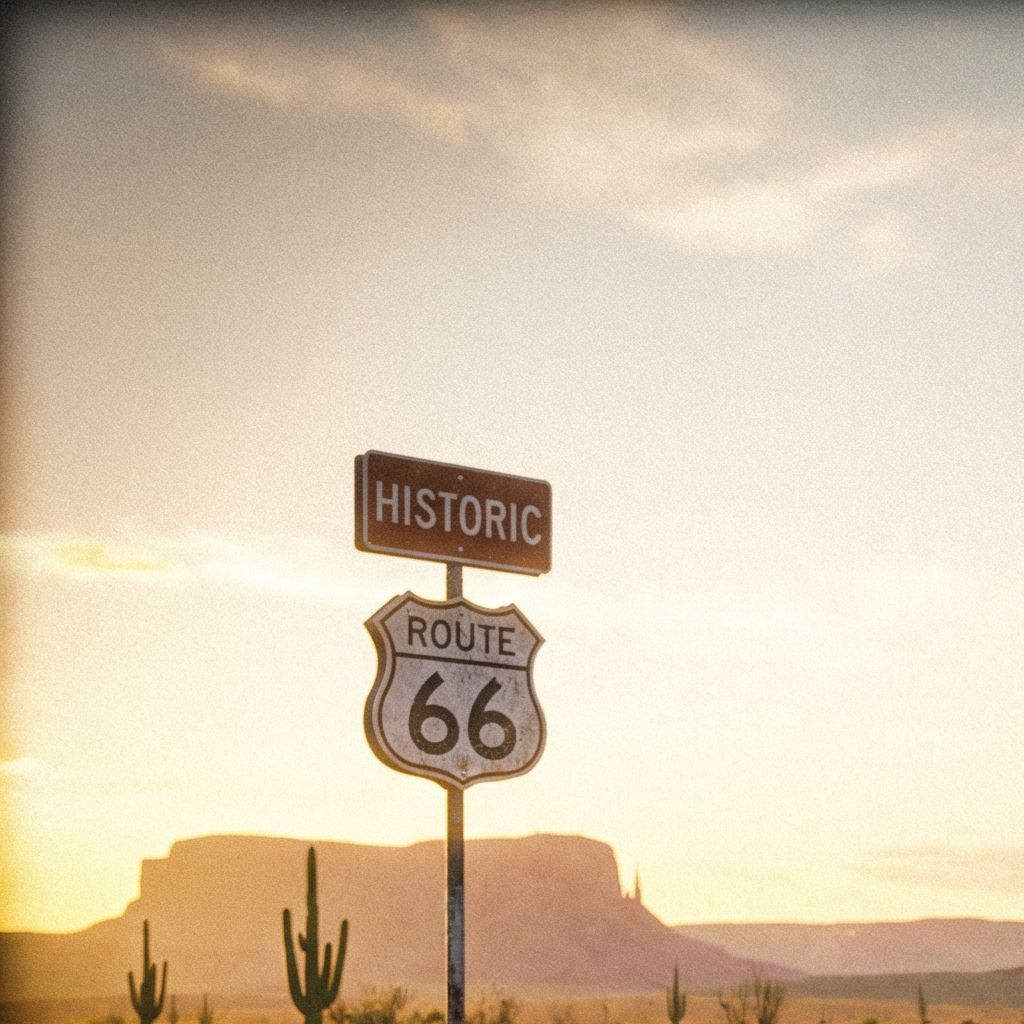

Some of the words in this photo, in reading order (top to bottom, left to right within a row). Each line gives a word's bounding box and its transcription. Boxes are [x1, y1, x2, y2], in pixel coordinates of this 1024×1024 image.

[375, 480, 542, 546] HISTORIC
[407, 615, 516, 656] ROUTE
[408, 671, 517, 761] 66
